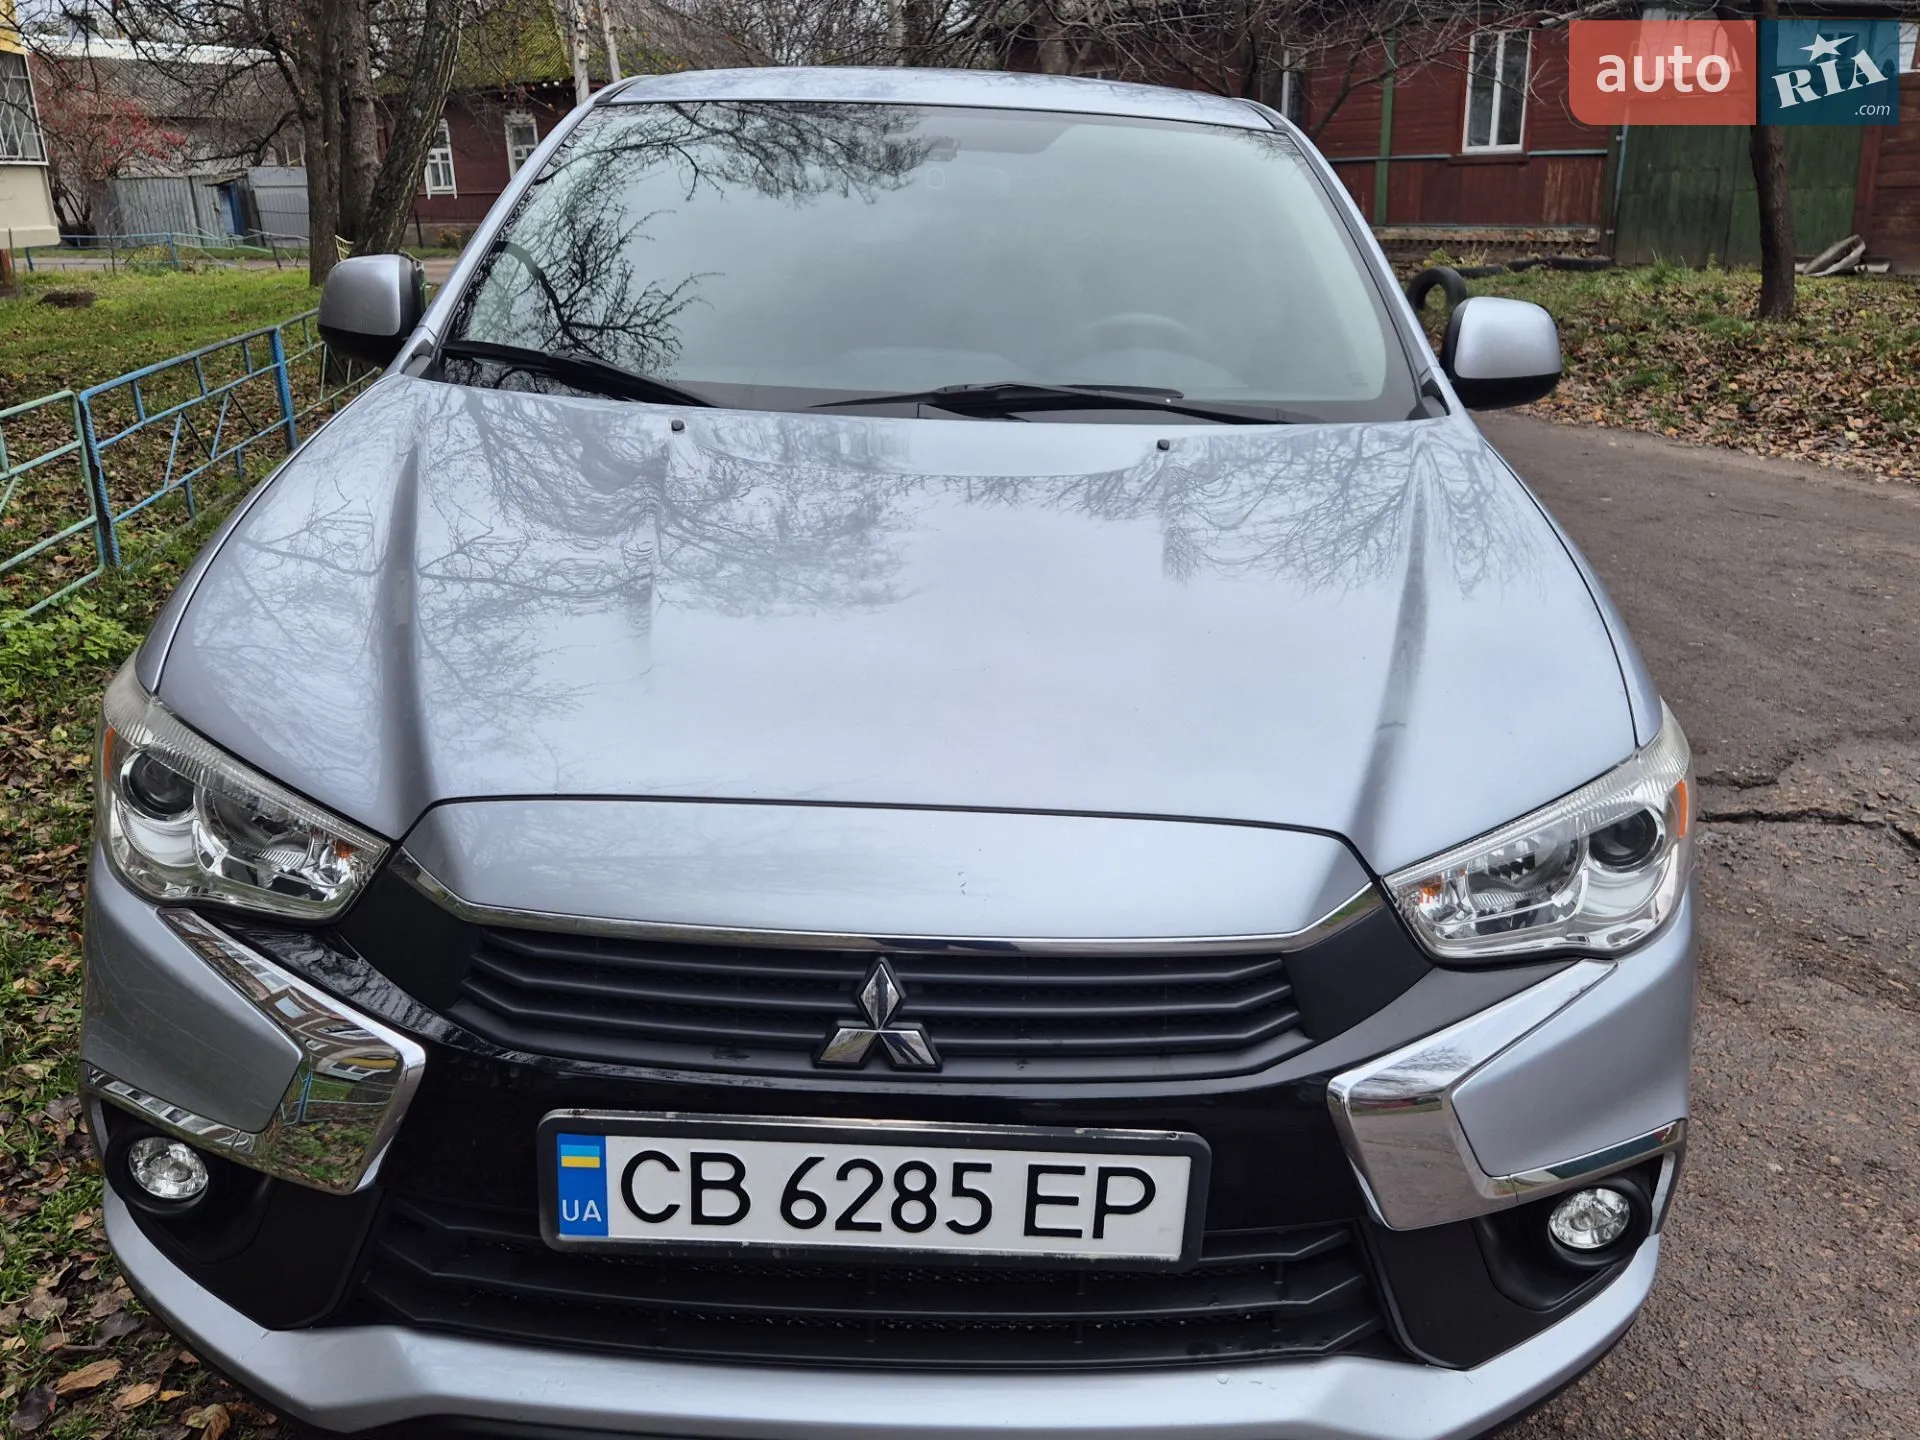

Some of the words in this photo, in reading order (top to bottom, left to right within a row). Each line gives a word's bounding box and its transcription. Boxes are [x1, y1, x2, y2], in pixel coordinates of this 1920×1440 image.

[561, 1198, 603, 1223] UA
[620, 1150, 752, 1226] CB
[779, 1155, 994, 1236] 6285
[1023, 1163, 1157, 1240] EP
